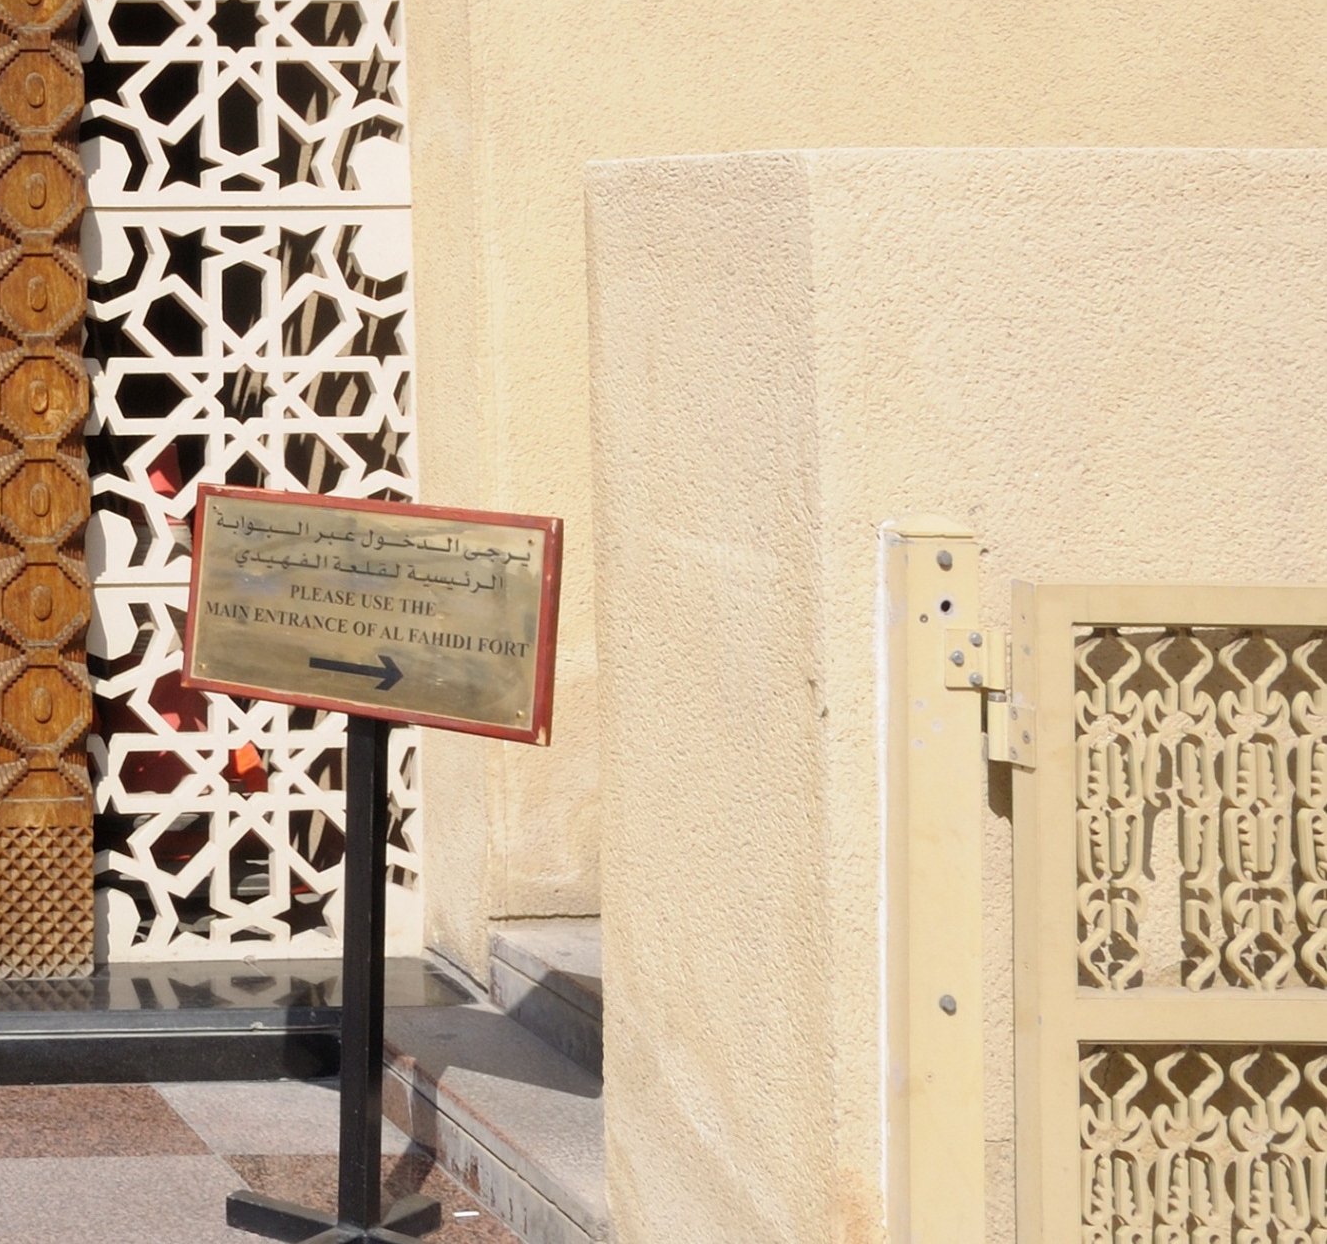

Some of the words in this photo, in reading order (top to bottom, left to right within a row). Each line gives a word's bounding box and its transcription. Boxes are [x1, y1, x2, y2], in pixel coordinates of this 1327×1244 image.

[216, 512, 309, 539] البوابة
[313, 529, 355, 546] عبر
[360, 529, 459, 553] الدخول
[333, 555, 400, 579] لقلعة
[407, 564, 503, 593] الرئيسية
[290, 584, 356, 607] PLEASE
[361, 593, 395, 612] USE
[399, 599, 438, 617] THE
[205, 601, 250, 619] MAIN
[253, 607, 348, 634] ENTRANCE
[352, 620, 378, 637] OF
[379, 626, 404, 642] AL
[408, 628, 472, 651] FAHIDI
[478, 638, 530, 658] FORT
